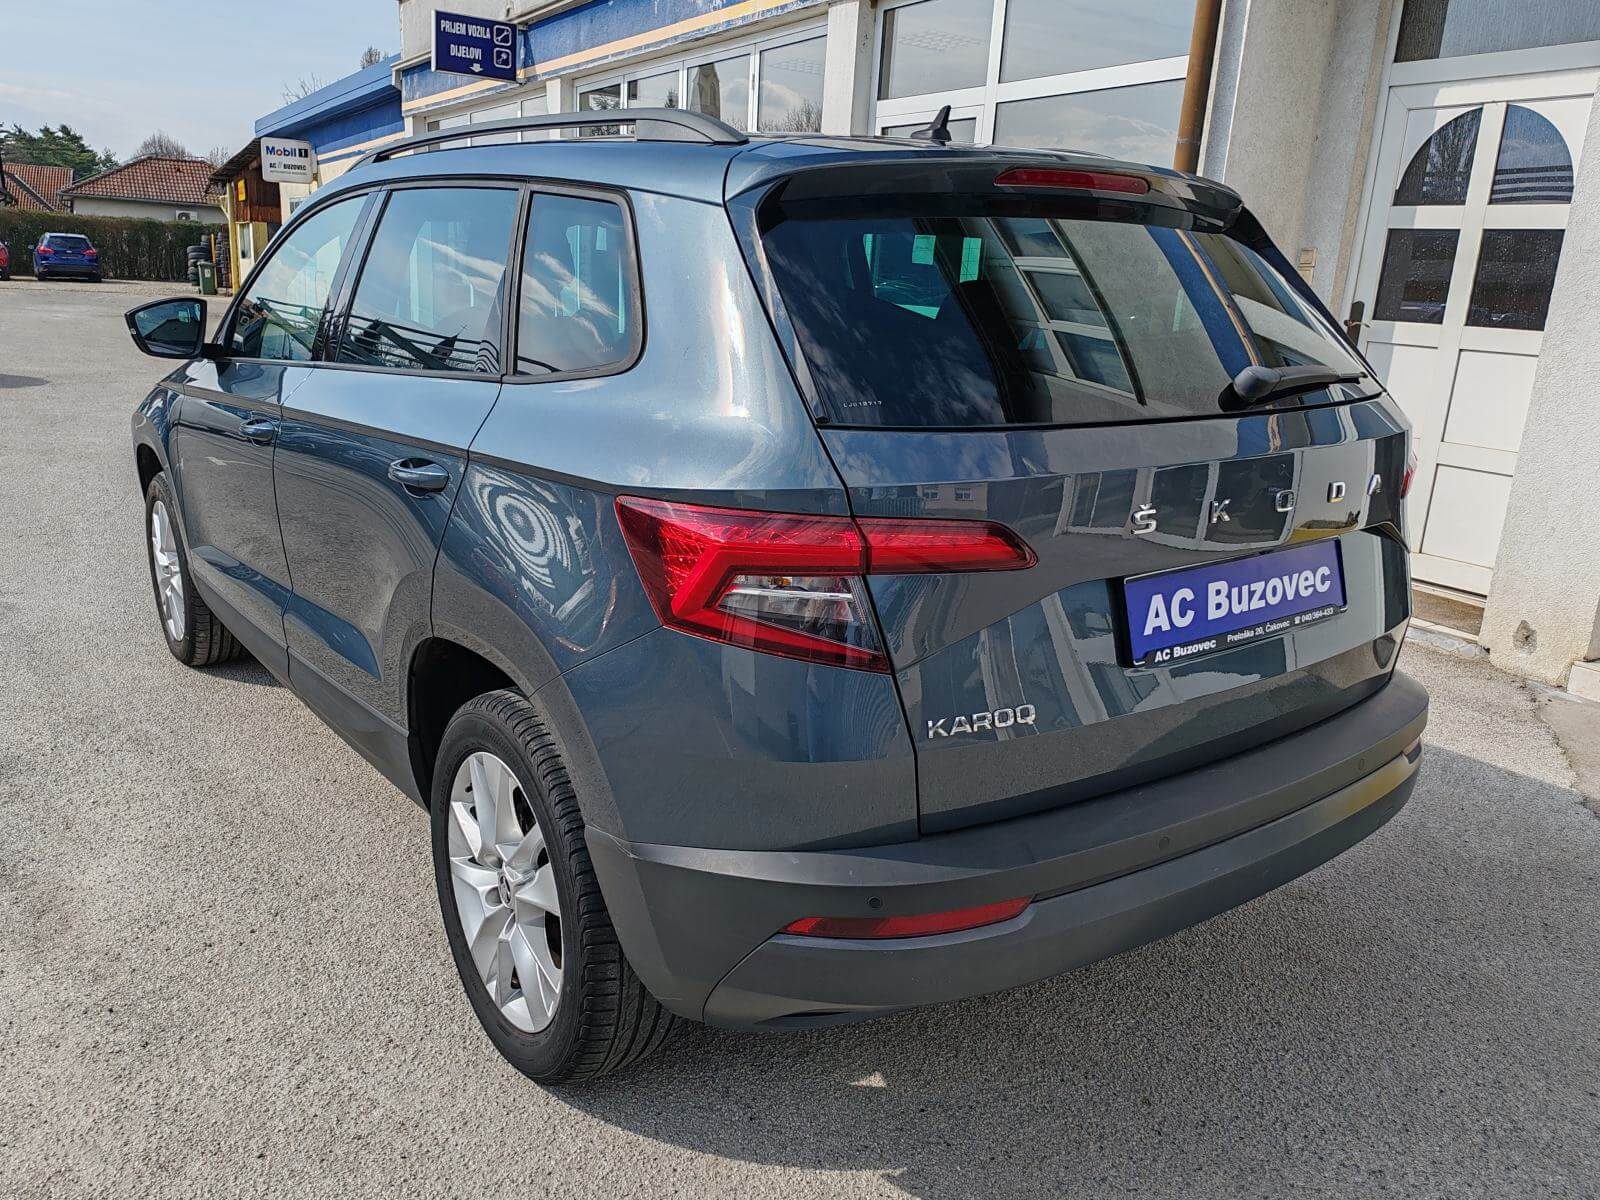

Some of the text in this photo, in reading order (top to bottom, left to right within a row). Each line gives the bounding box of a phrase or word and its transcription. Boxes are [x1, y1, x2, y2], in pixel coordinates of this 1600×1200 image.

[440, 20, 491, 40] PRIJEM VOZILA
[450, 44, 482, 61] DIJELOVI
[265, 145, 309, 159] Mobil 1
[1131, 473, 1382, 535] ŠKODA
[1143, 566, 1332, 636] AC Buzovec
[1154, 649, 1171, 663] AC
[1173, 639, 1217, 657] Buzovec
[927, 704, 1037, 739] KAROQ
